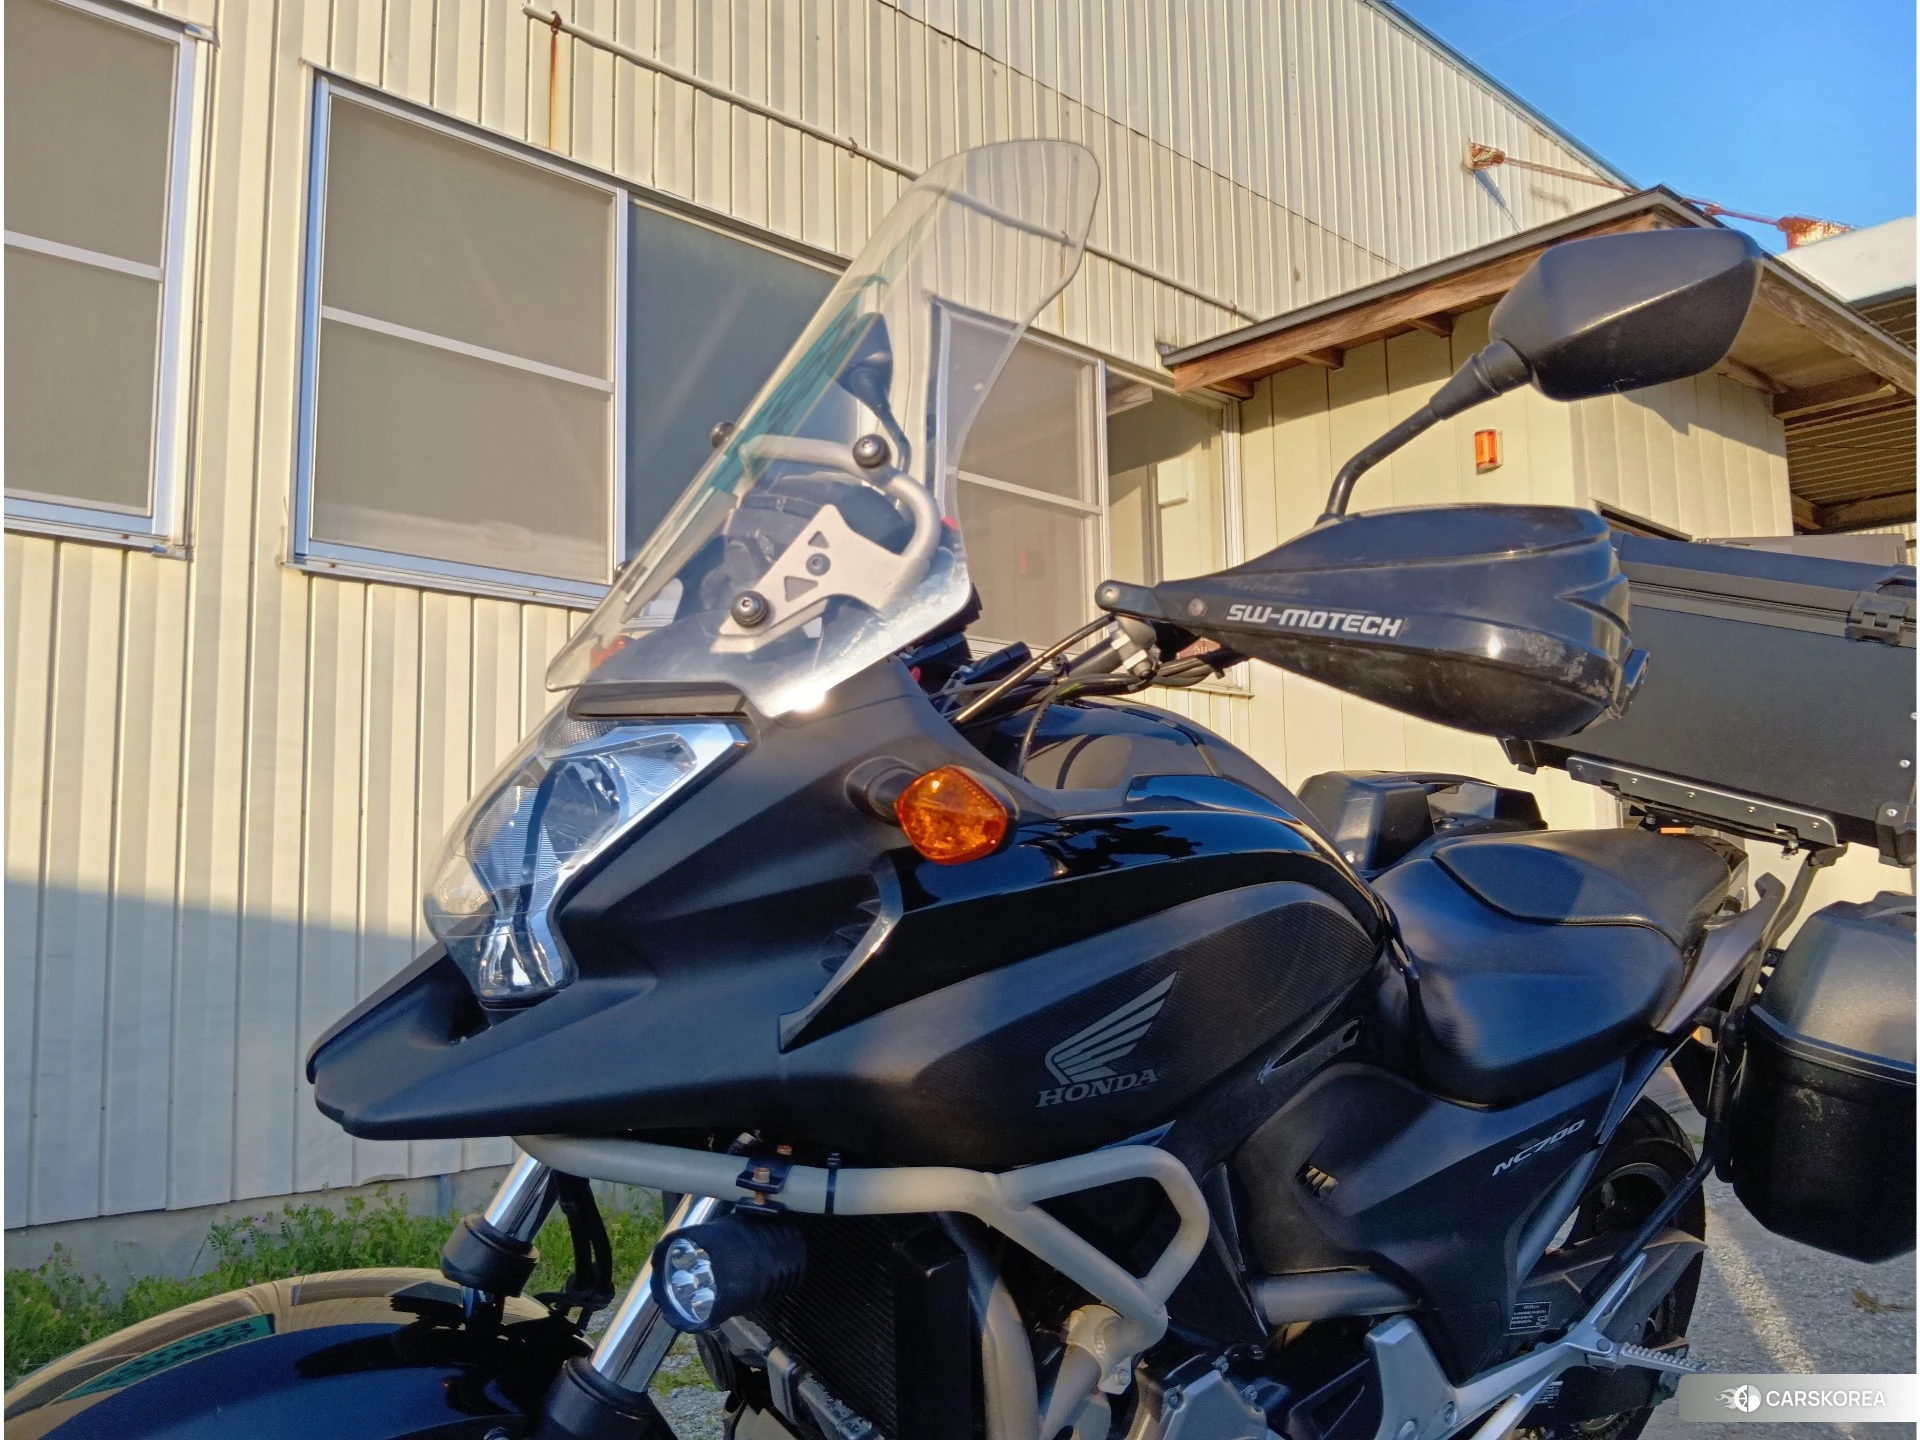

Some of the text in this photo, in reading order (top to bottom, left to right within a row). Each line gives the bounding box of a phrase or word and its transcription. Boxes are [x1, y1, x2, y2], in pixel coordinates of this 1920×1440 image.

[1226, 604, 1403, 638] SW-MOTECH
[1036, 1068, 1158, 1107] HONDA
[1492, 1118, 1585, 1176] NC700
